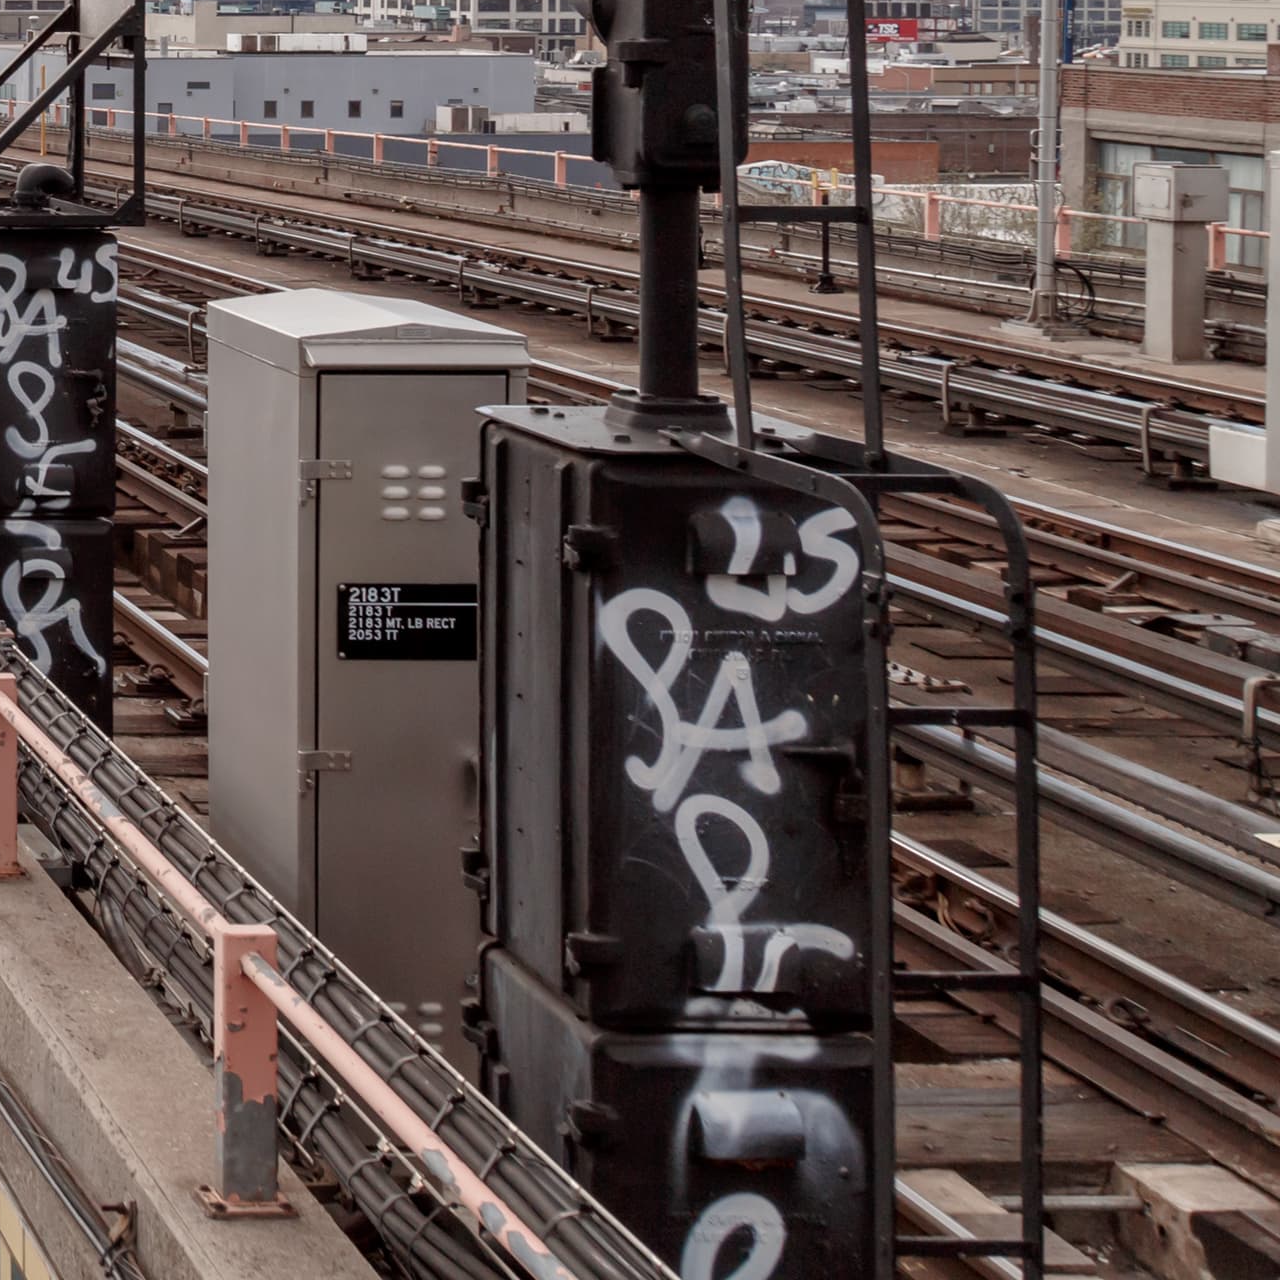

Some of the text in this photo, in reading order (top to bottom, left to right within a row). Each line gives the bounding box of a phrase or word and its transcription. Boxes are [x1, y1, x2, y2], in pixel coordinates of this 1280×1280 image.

[348, 605, 394, 617] 2183 T
[348, 617, 457, 630] 2183 MT. LB RECT
[348, 629, 400, 641] 2053 TT
